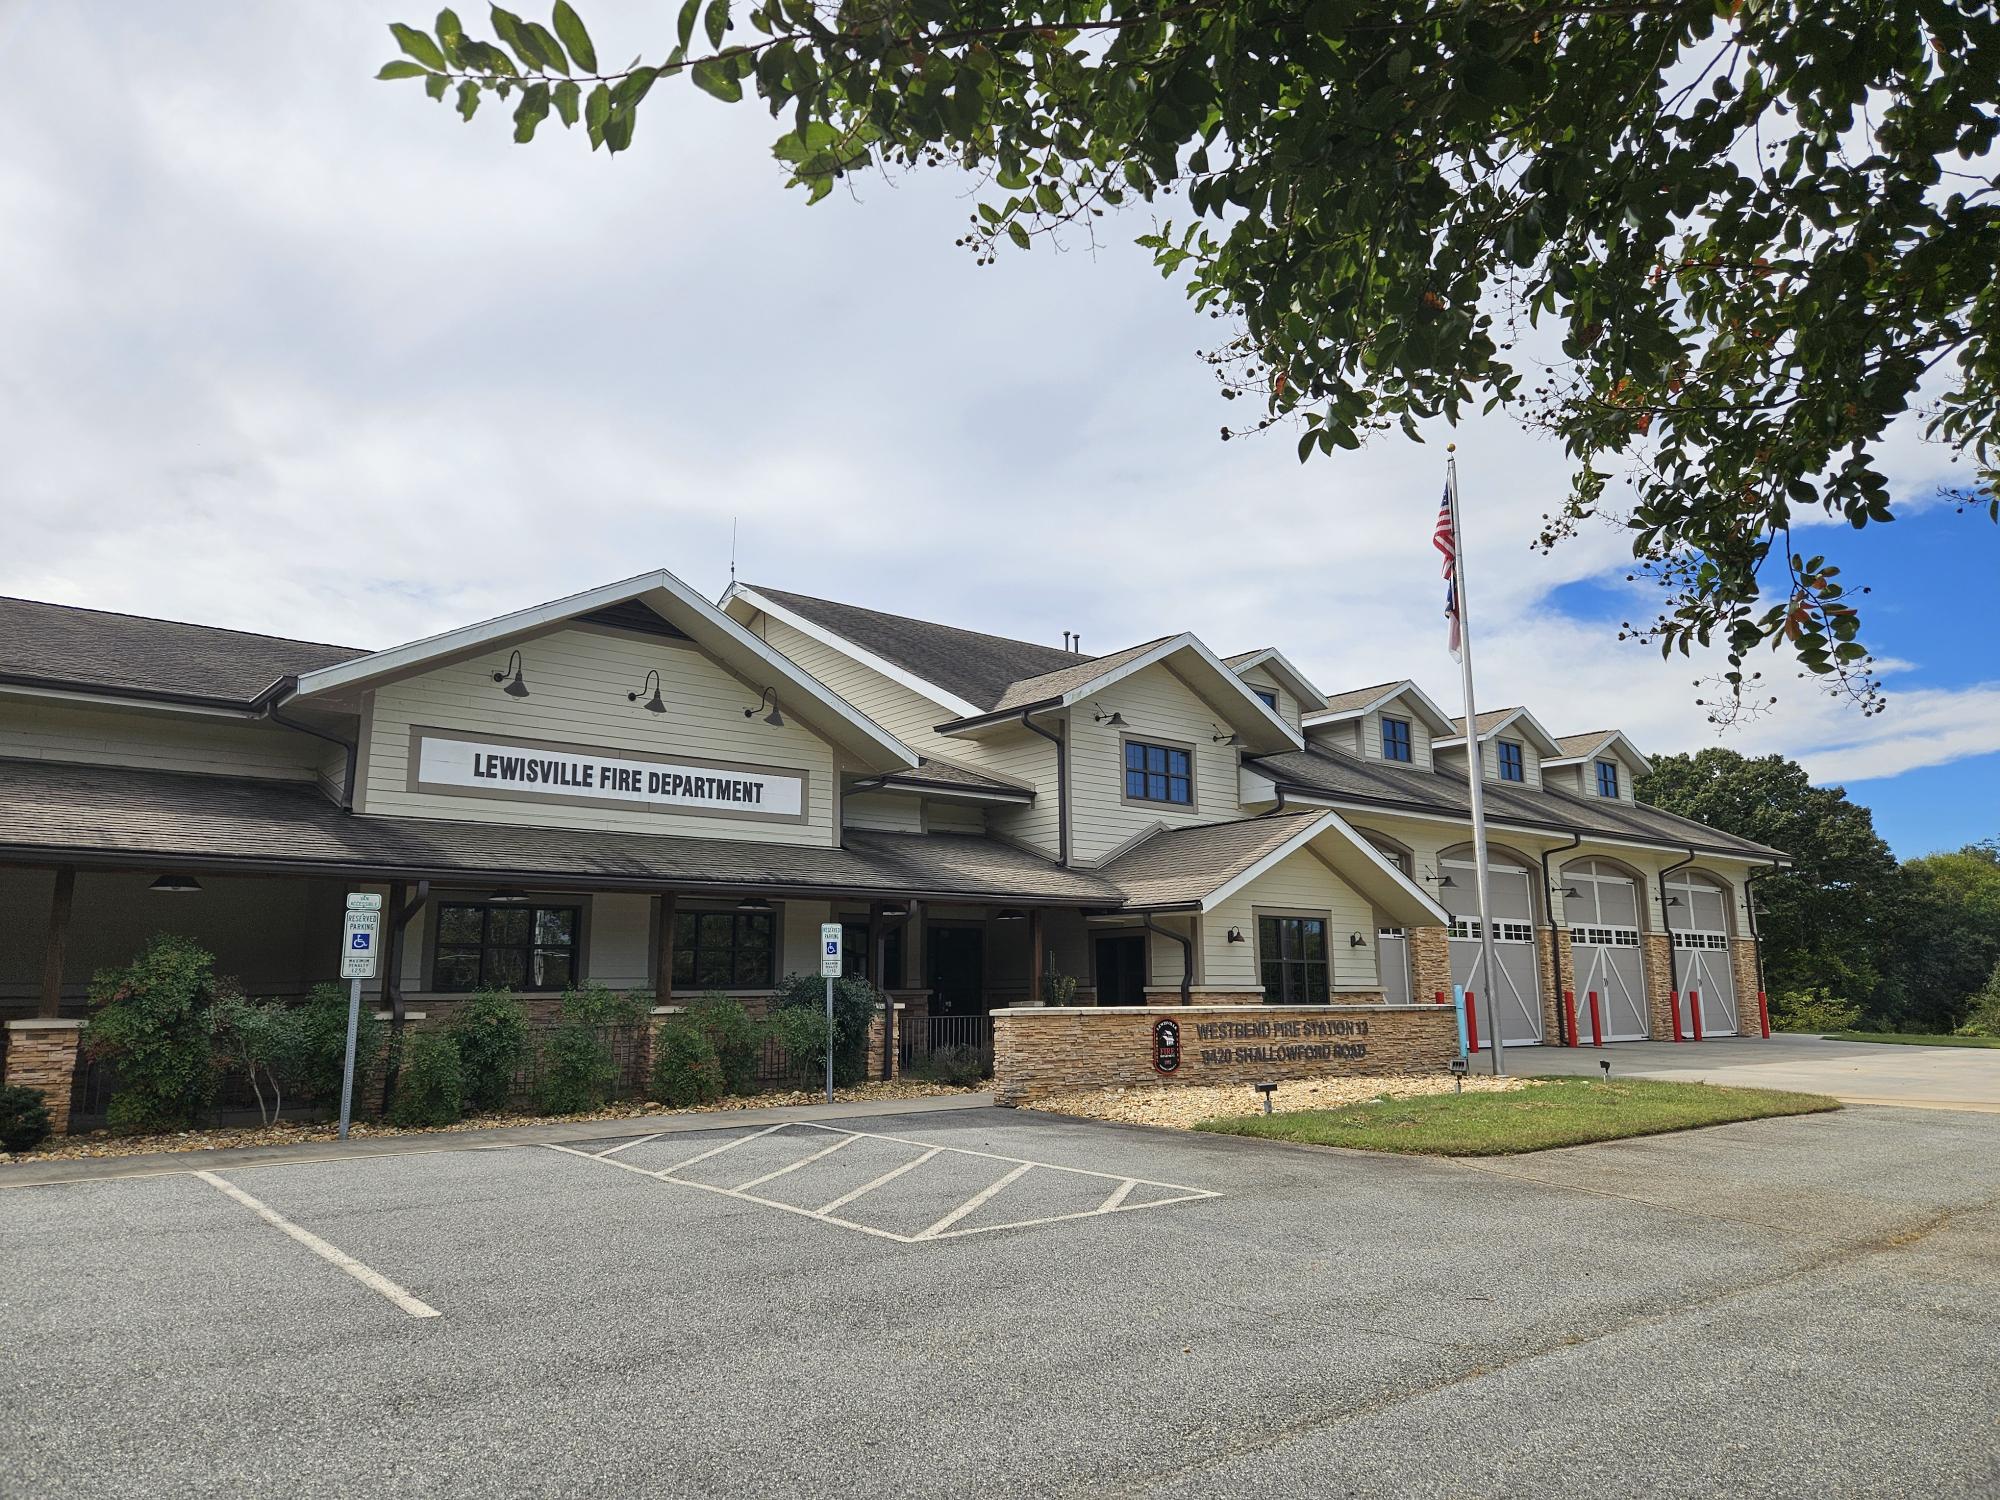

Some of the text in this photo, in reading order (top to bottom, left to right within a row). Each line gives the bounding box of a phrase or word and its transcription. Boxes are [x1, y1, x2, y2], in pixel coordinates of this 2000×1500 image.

[474, 753, 764, 804] LEWISVILLE FIRE DEPARTMENT
[348, 914, 376, 923] RESERVED
[349, 923, 374, 931] PARKING
[1196, 1021, 1271, 1040] WESTBEND
[1273, 1020, 1301, 1038] FIRE
[1303, 1020, 1356, 1037] STATION
[1356, 1020, 1369, 1036] 13
[1235, 1044, 1331, 1063] SHALLOWFORD
[1333, 1043, 1367, 1060] ROAD
